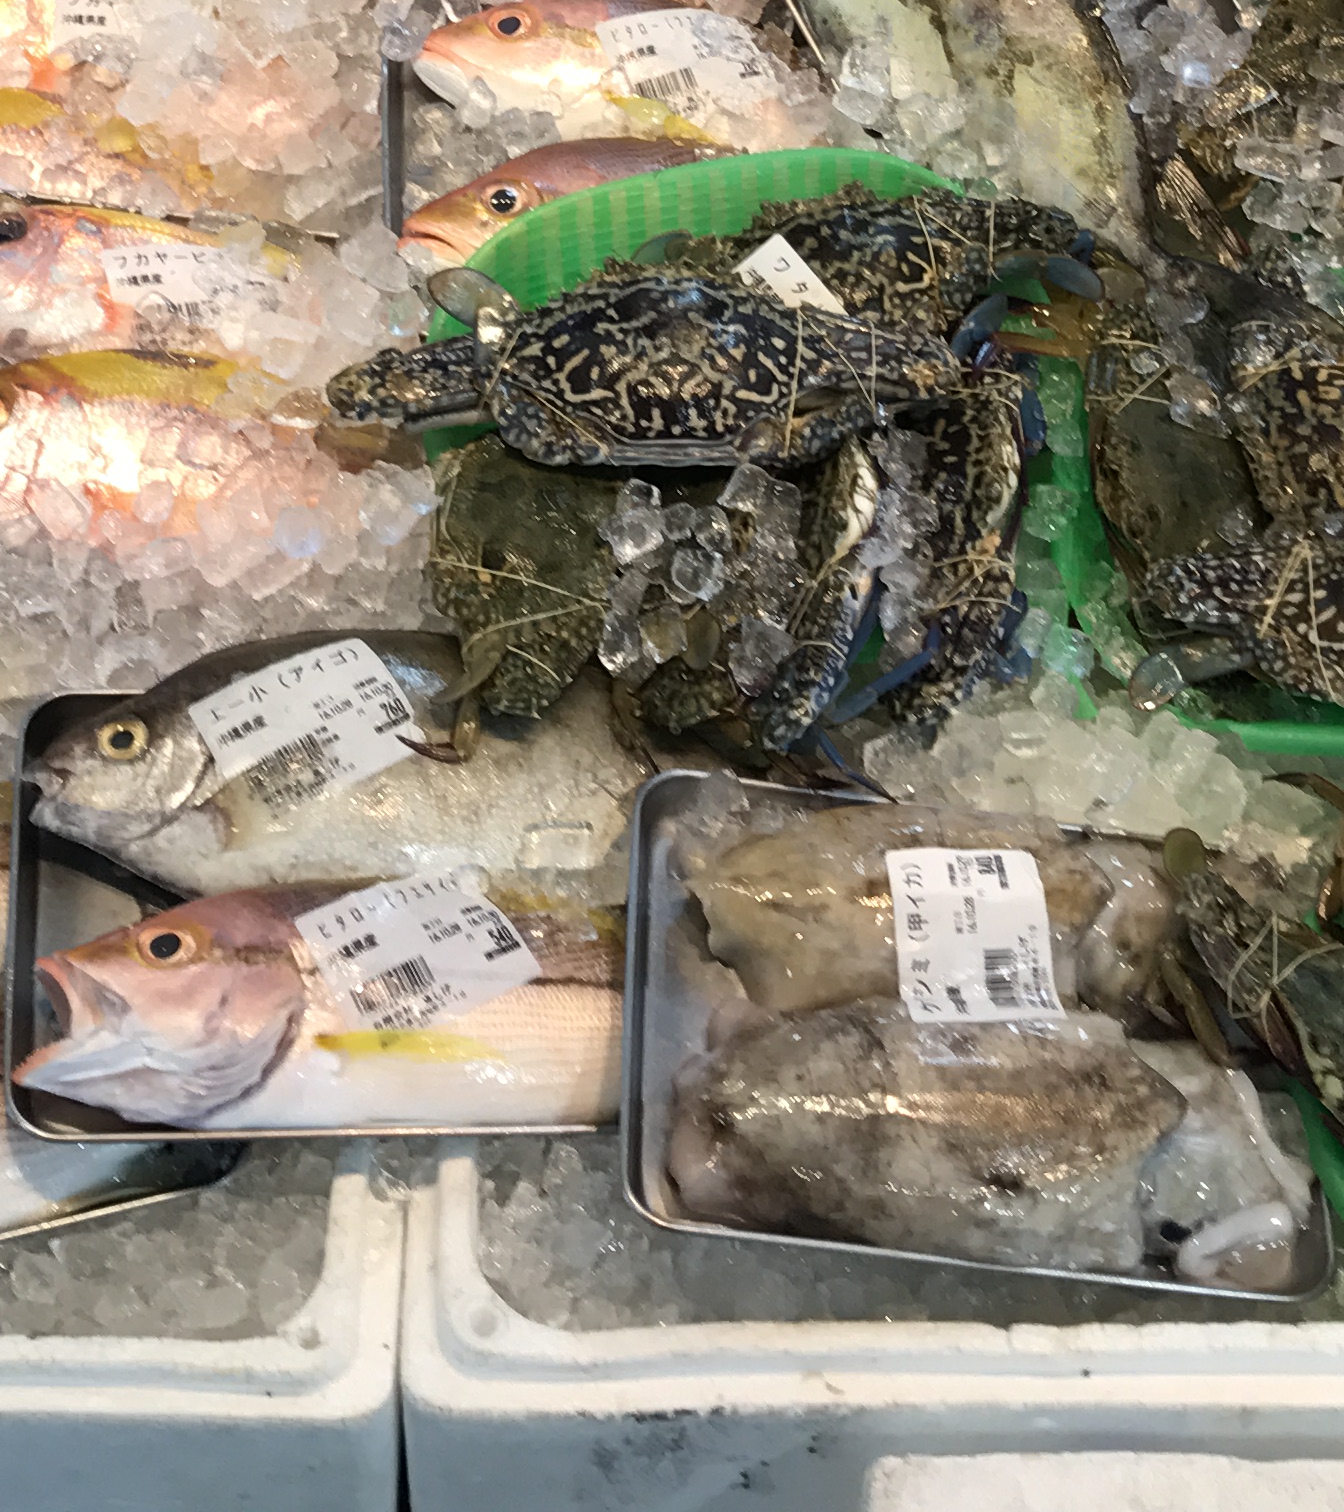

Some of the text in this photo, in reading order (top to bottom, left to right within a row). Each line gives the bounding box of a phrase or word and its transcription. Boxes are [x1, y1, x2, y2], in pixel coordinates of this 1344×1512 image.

[62, 14, 107, 27] 沖縄県産
[774, 256, 810, 295] ワタ
[210, 646, 359, 723] エー小（アイゴ）
[318, 878, 458, 938] ビタロー（フエダイ
[489, 926, 513, 948] 540
